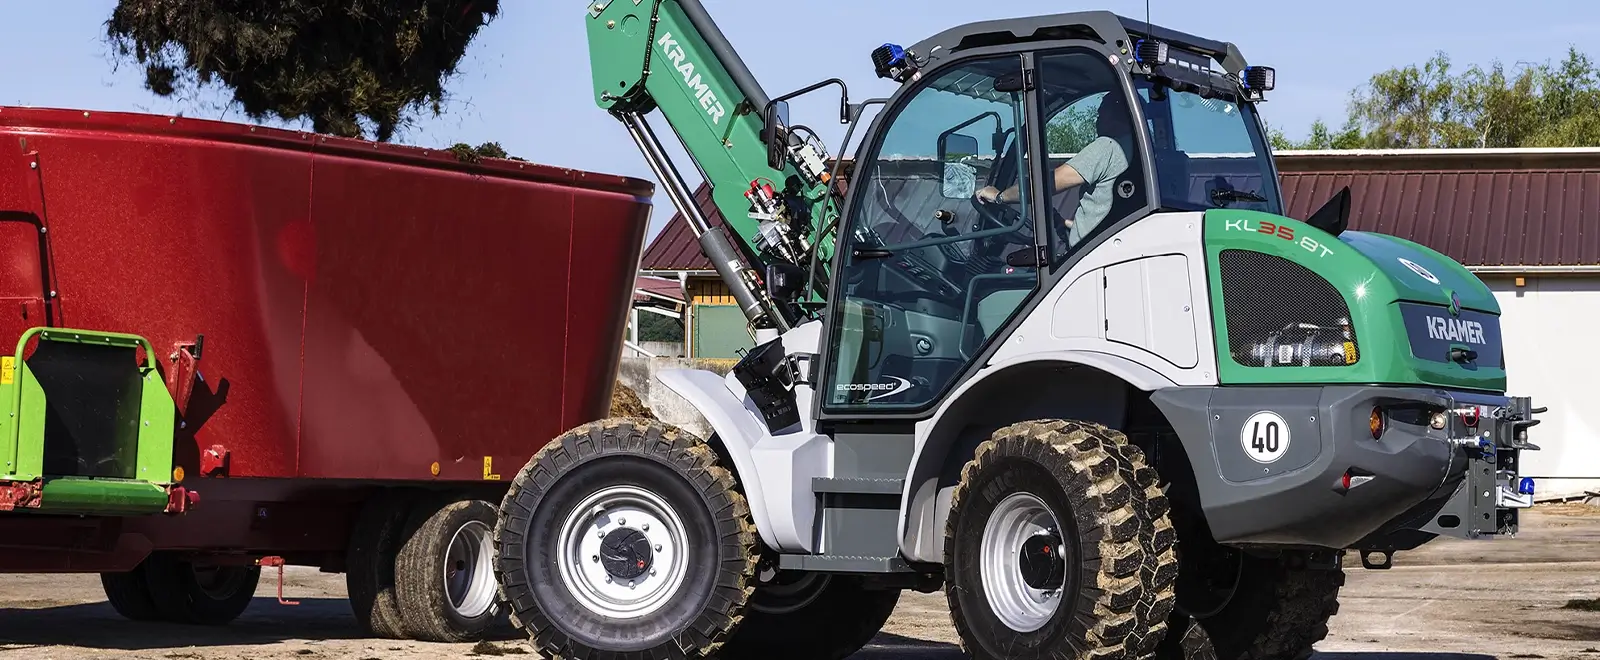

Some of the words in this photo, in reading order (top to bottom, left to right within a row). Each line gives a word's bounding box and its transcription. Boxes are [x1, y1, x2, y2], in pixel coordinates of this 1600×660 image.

[657, 31, 725, 125] KRAMER
[1225, 219, 1334, 258] KL35.8T
[1426, 315, 1487, 345] KRAMER
[1251, 421, 1279, 453] 40
